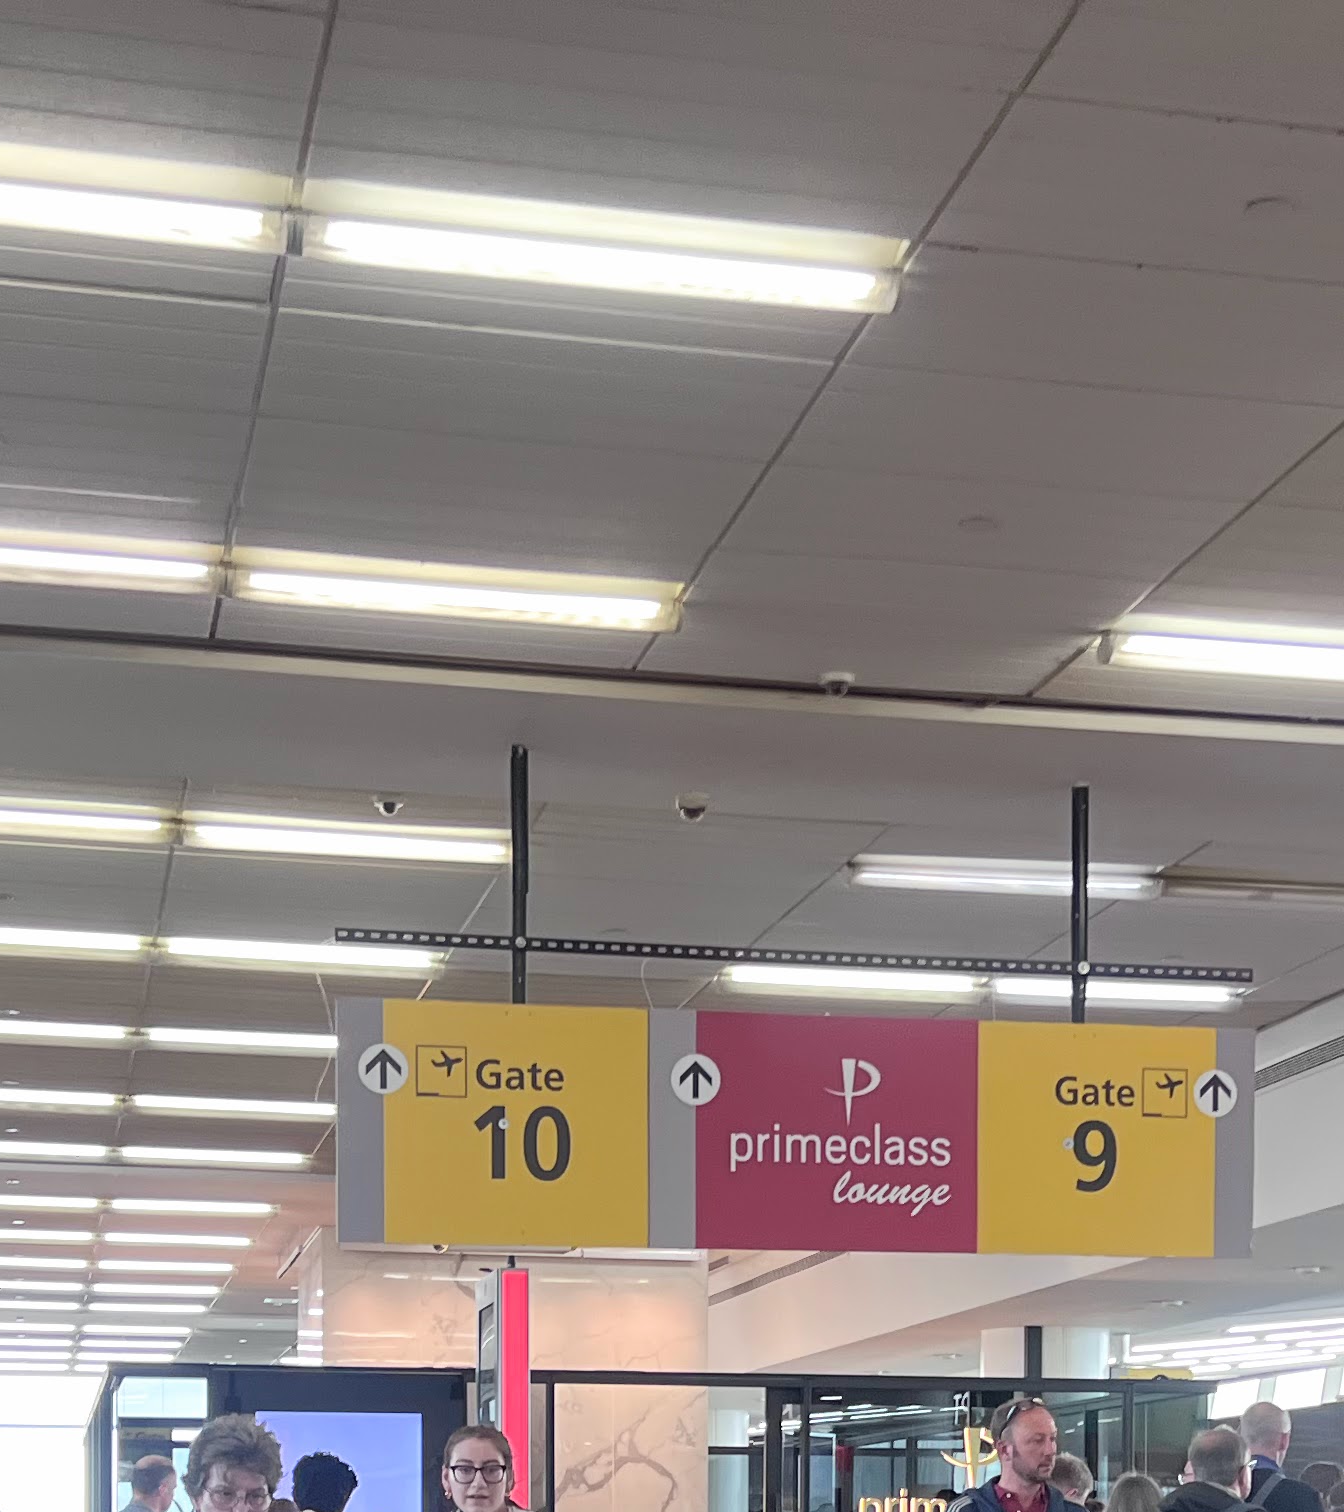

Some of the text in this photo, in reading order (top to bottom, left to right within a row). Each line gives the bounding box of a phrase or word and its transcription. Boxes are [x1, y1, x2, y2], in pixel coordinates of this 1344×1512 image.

[476, 1059, 564, 1092] Gate
[1055, 1076, 1135, 1107] Gate
[474, 1105, 571, 1182] 10
[729, 1123, 951, 1172] primeclass
[1073, 1120, 1117, 1193] 9
[833, 1170, 952, 1217] lounge
